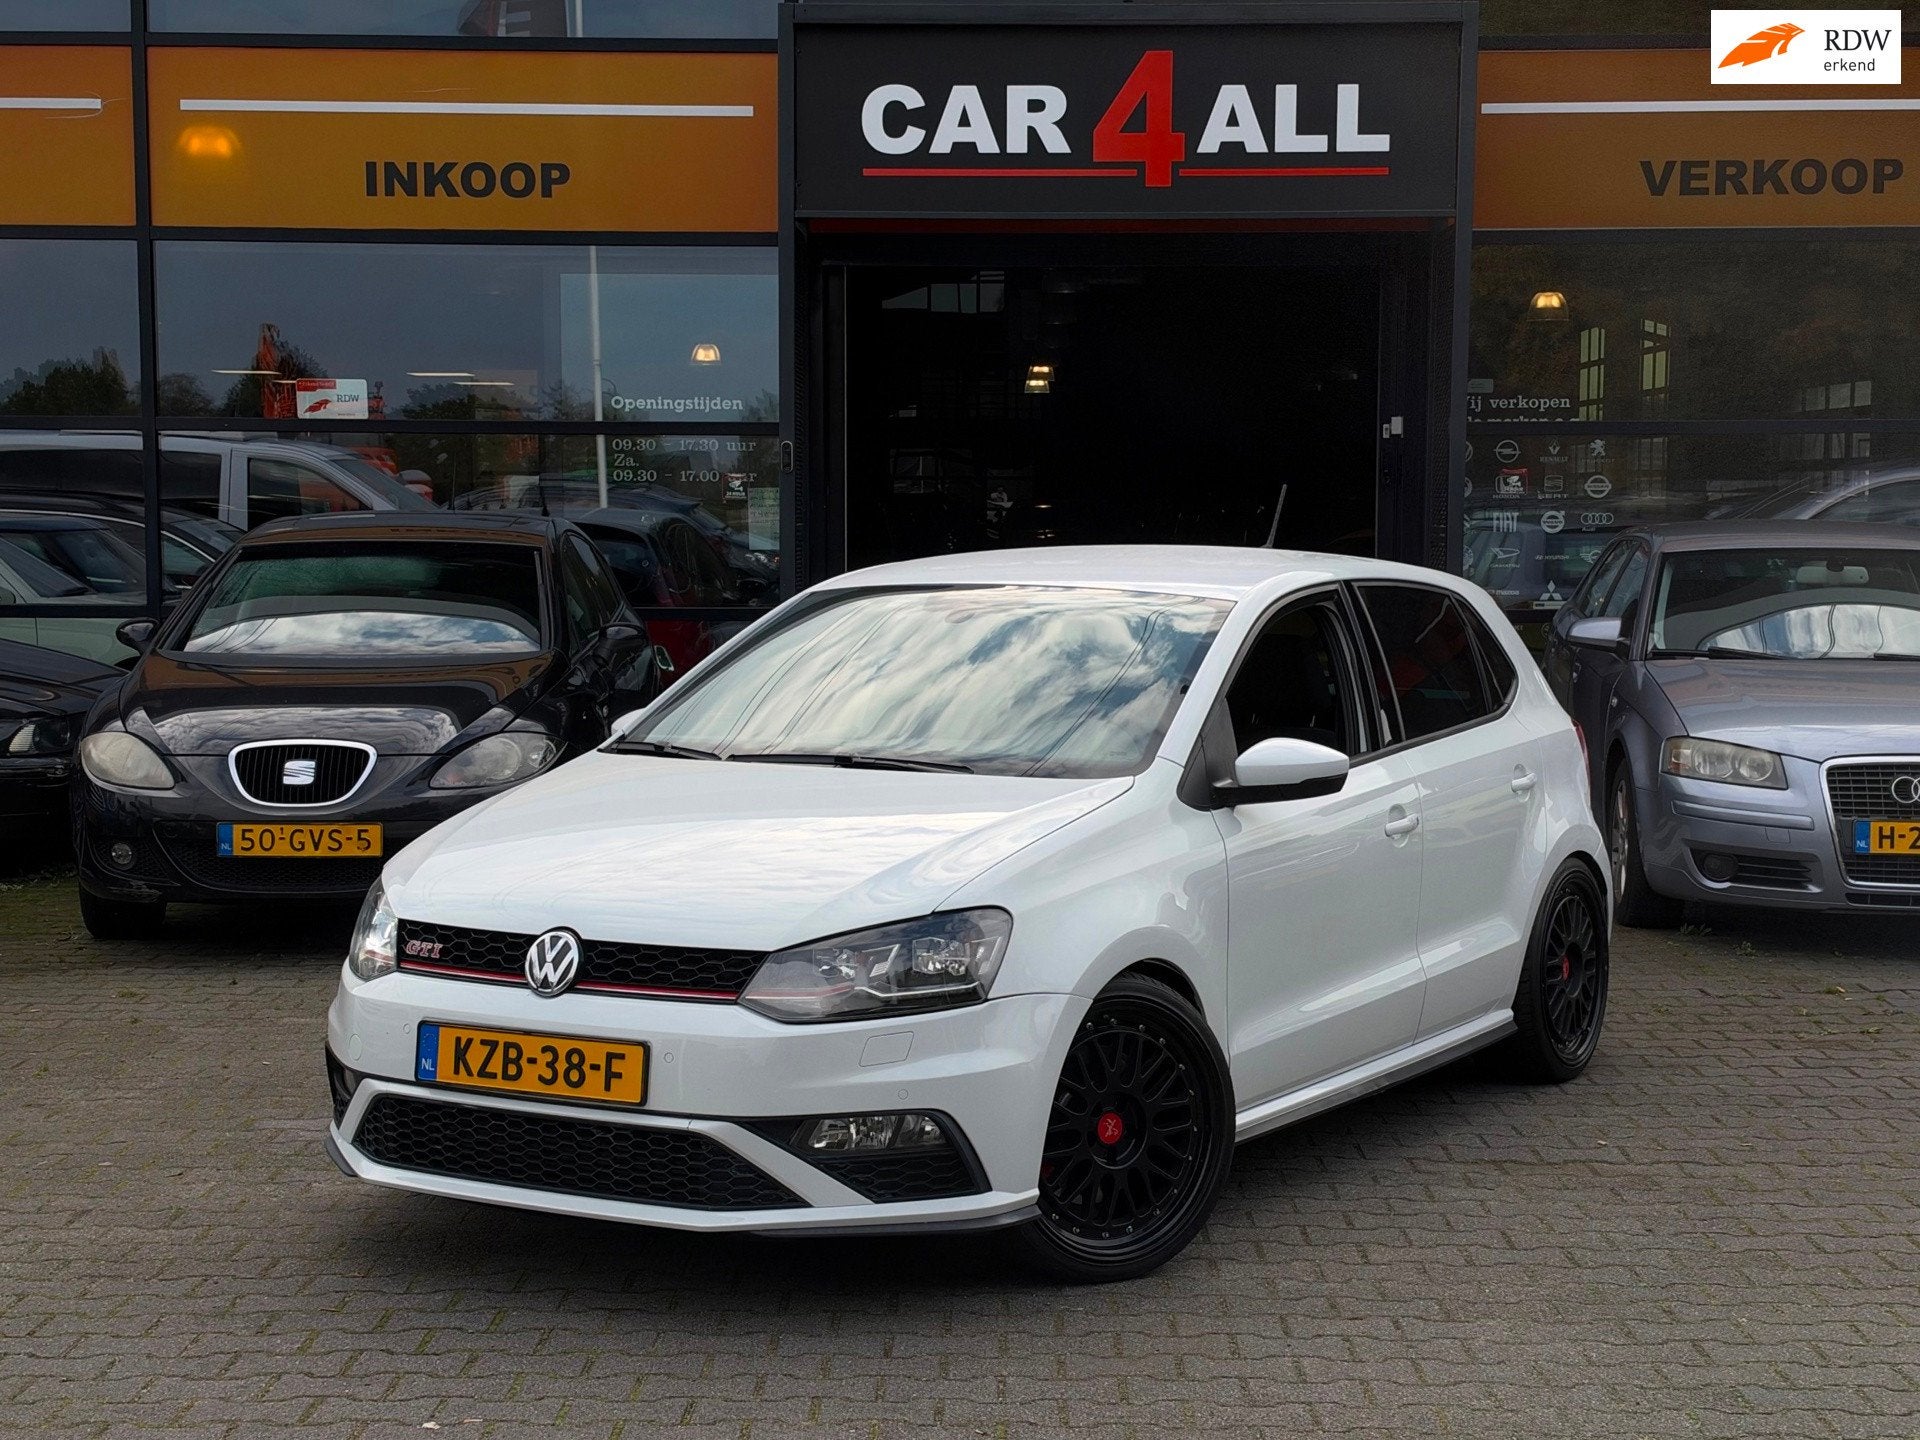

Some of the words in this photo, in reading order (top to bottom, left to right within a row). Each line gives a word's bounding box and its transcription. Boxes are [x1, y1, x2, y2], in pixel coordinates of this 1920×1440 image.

[861, 83, 1072, 155] CAR
[1092, 50, 1186, 188] 4
[1196, 83, 1391, 154] ALL
[365, 160, 572, 199] INKOOP
[1639, 158, 1905, 197] VERKOOP
[336, 394, 361, 404] RDW
[610, 395, 744, 413] Openingstijden
[1489, 395, 1571, 412] verkopen
[612, 438, 657, 451] 09.30
[679, 439, 719, 451] 17.30
[726, 441, 757, 452] uur
[614, 453, 640, 467] Za.
[613, 469, 658, 482] 09.30
[680, 470, 720, 482] 17.00
[1492, 511, 1520, 533] FIAT
[221, 842, 232, 850] NL
[238, 826, 373, 853] 50-GVS-5
[1856, 839, 1868, 848] NL
[405, 940, 443, 959] GTI
[421, 1057, 435, 1072] NL
[452, 1035, 626, 1093] KZB-38-F
